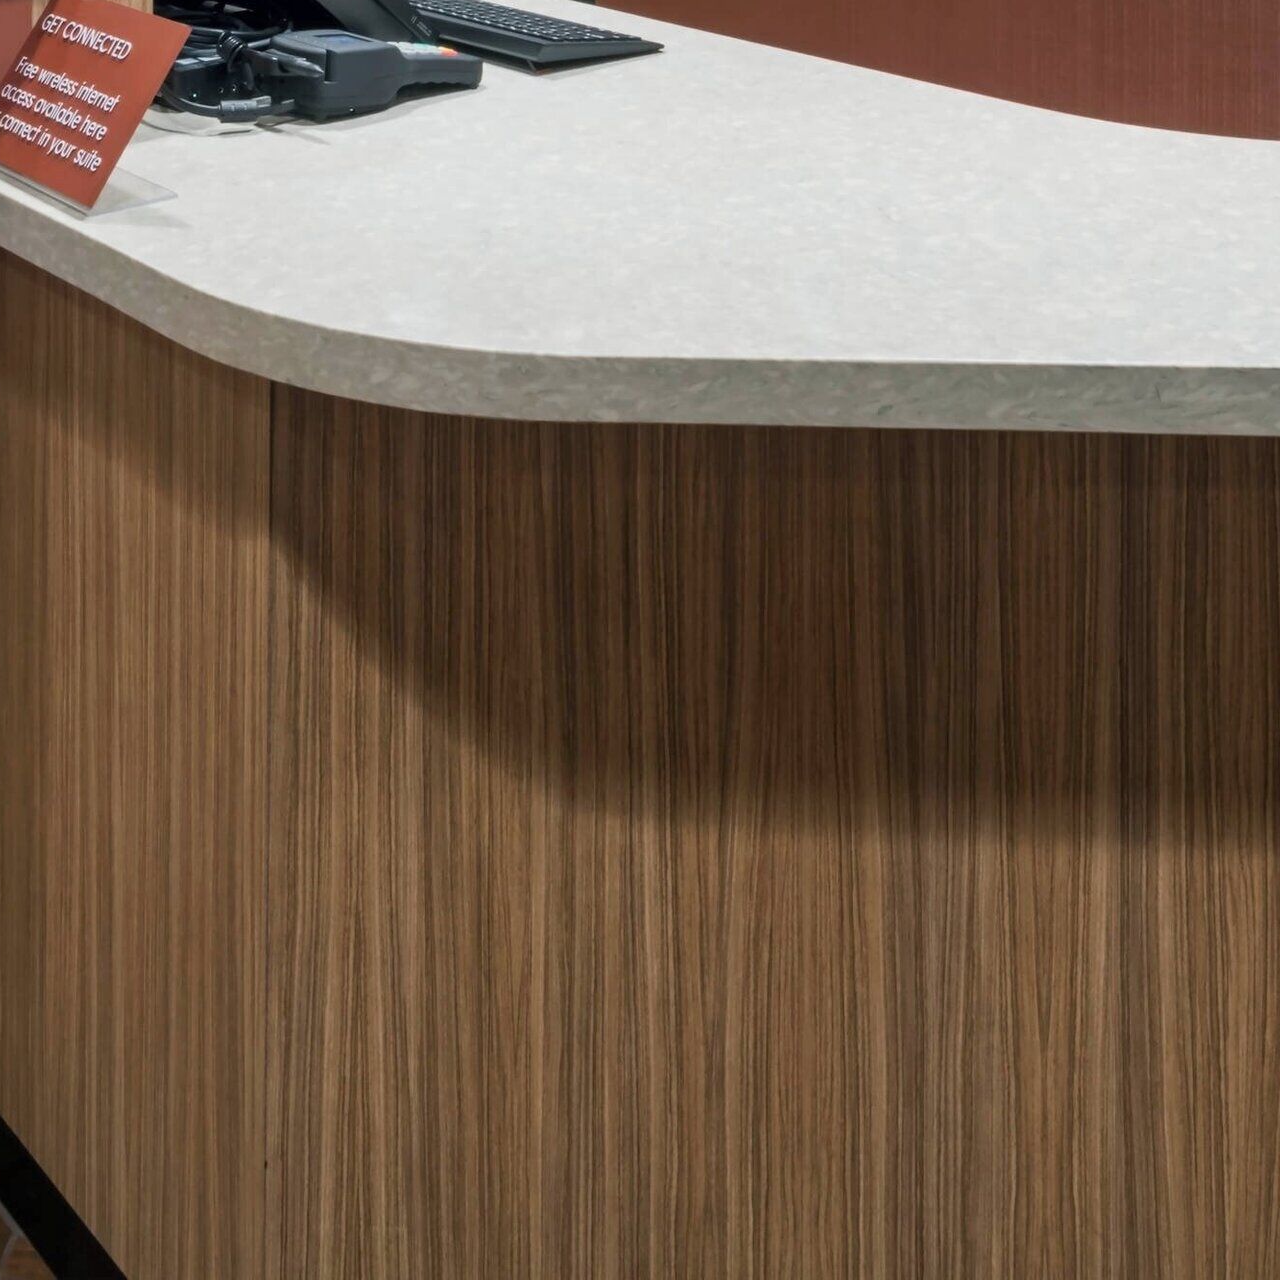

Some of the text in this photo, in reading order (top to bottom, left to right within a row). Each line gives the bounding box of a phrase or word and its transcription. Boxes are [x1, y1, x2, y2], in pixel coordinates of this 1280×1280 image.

[41, 13, 133, 61] GET CONNECTED
[1, 83, 108, 141] access available here
[14, 56, 121, 113] Free wireless internet
[0, 111, 41, 142] connect
[39, 128, 49, 148] in
[47, 137, 75, 160] your
[73, 146, 102, 172] suite
